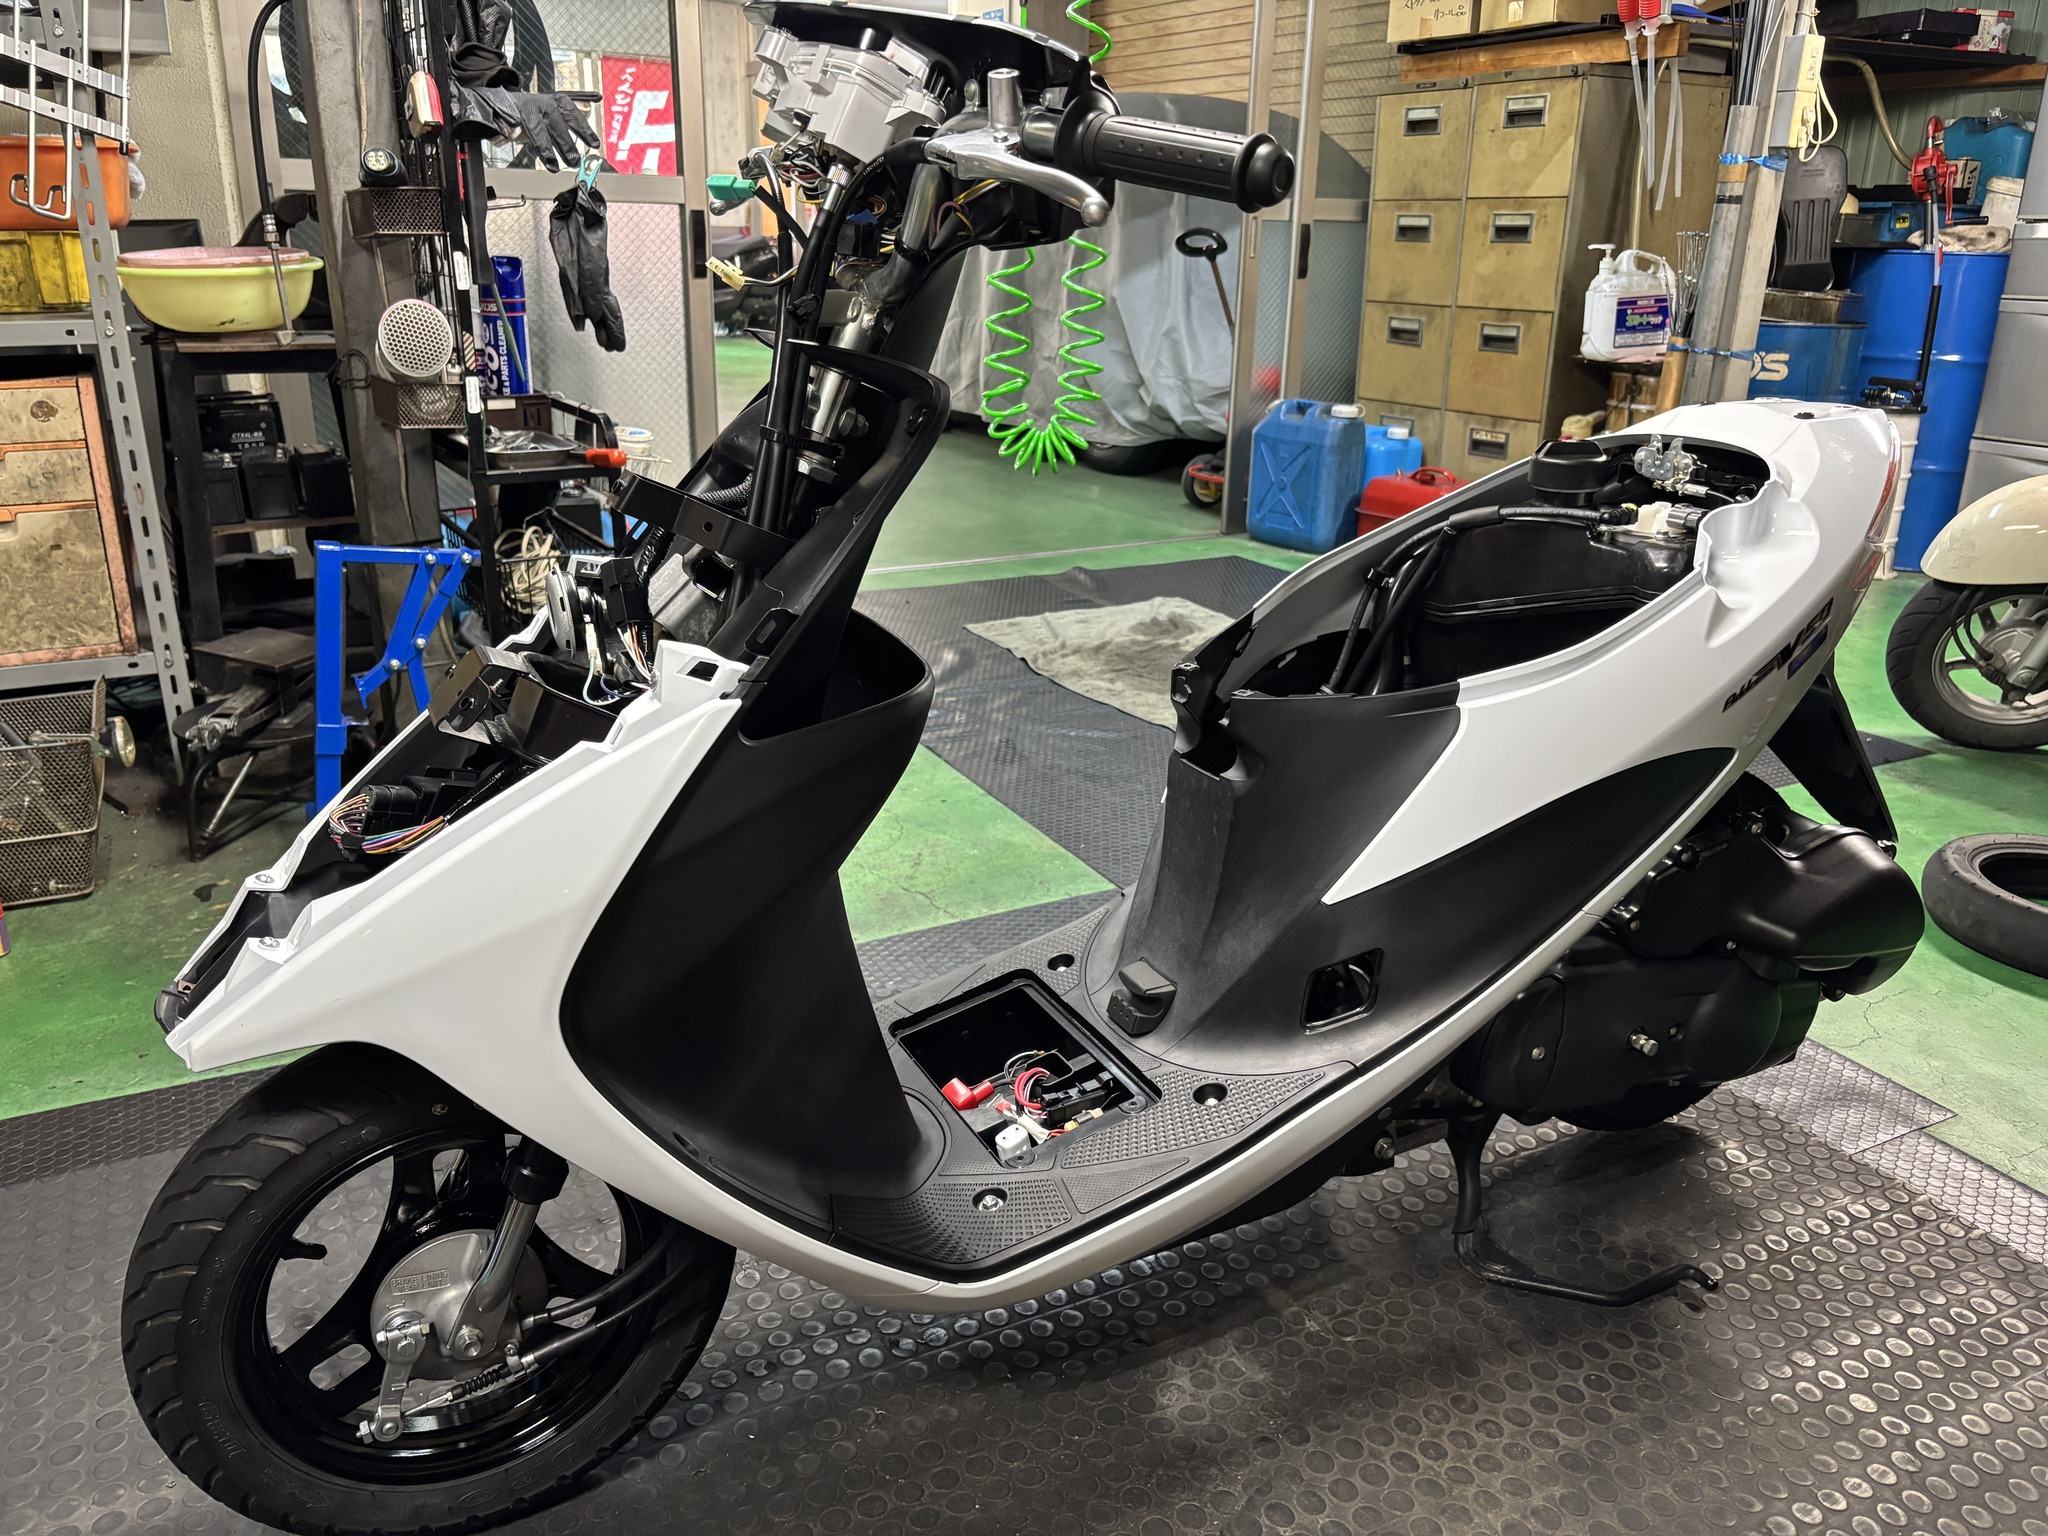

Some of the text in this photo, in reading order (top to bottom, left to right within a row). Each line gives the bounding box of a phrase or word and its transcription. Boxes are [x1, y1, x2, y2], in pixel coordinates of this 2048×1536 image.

[499, 354, 510, 381] PARTS
[391, 1270, 448, 1287] BRAKE LINING
[422, 1279, 443, 1289] LIMIT
